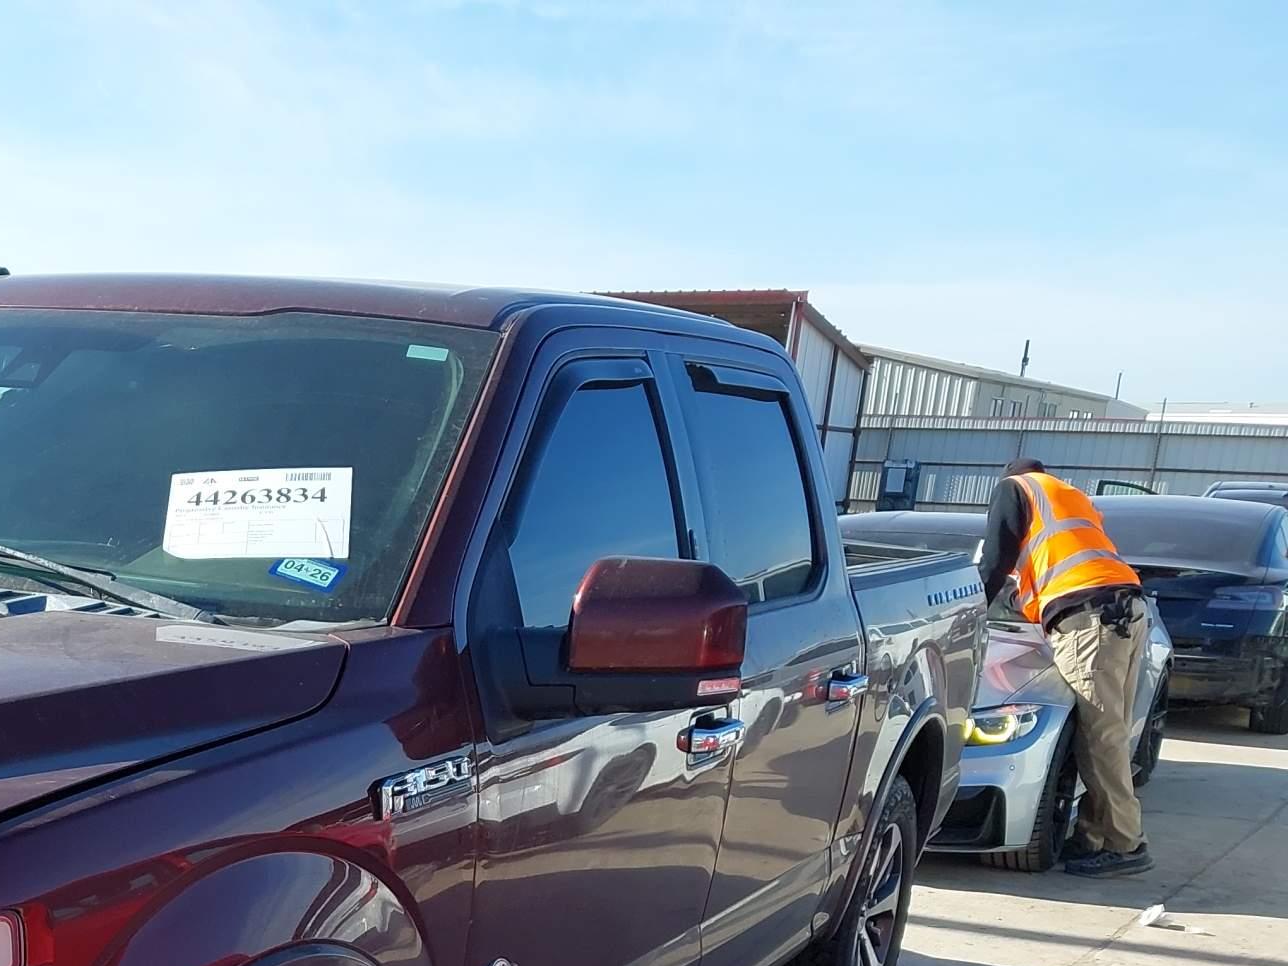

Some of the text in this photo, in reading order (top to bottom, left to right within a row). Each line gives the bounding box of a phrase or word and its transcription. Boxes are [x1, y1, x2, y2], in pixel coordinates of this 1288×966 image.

[187, 486, 328, 506] 44263834
[283, 560, 305, 573] 04
[309, 568, 332, 582] 26
